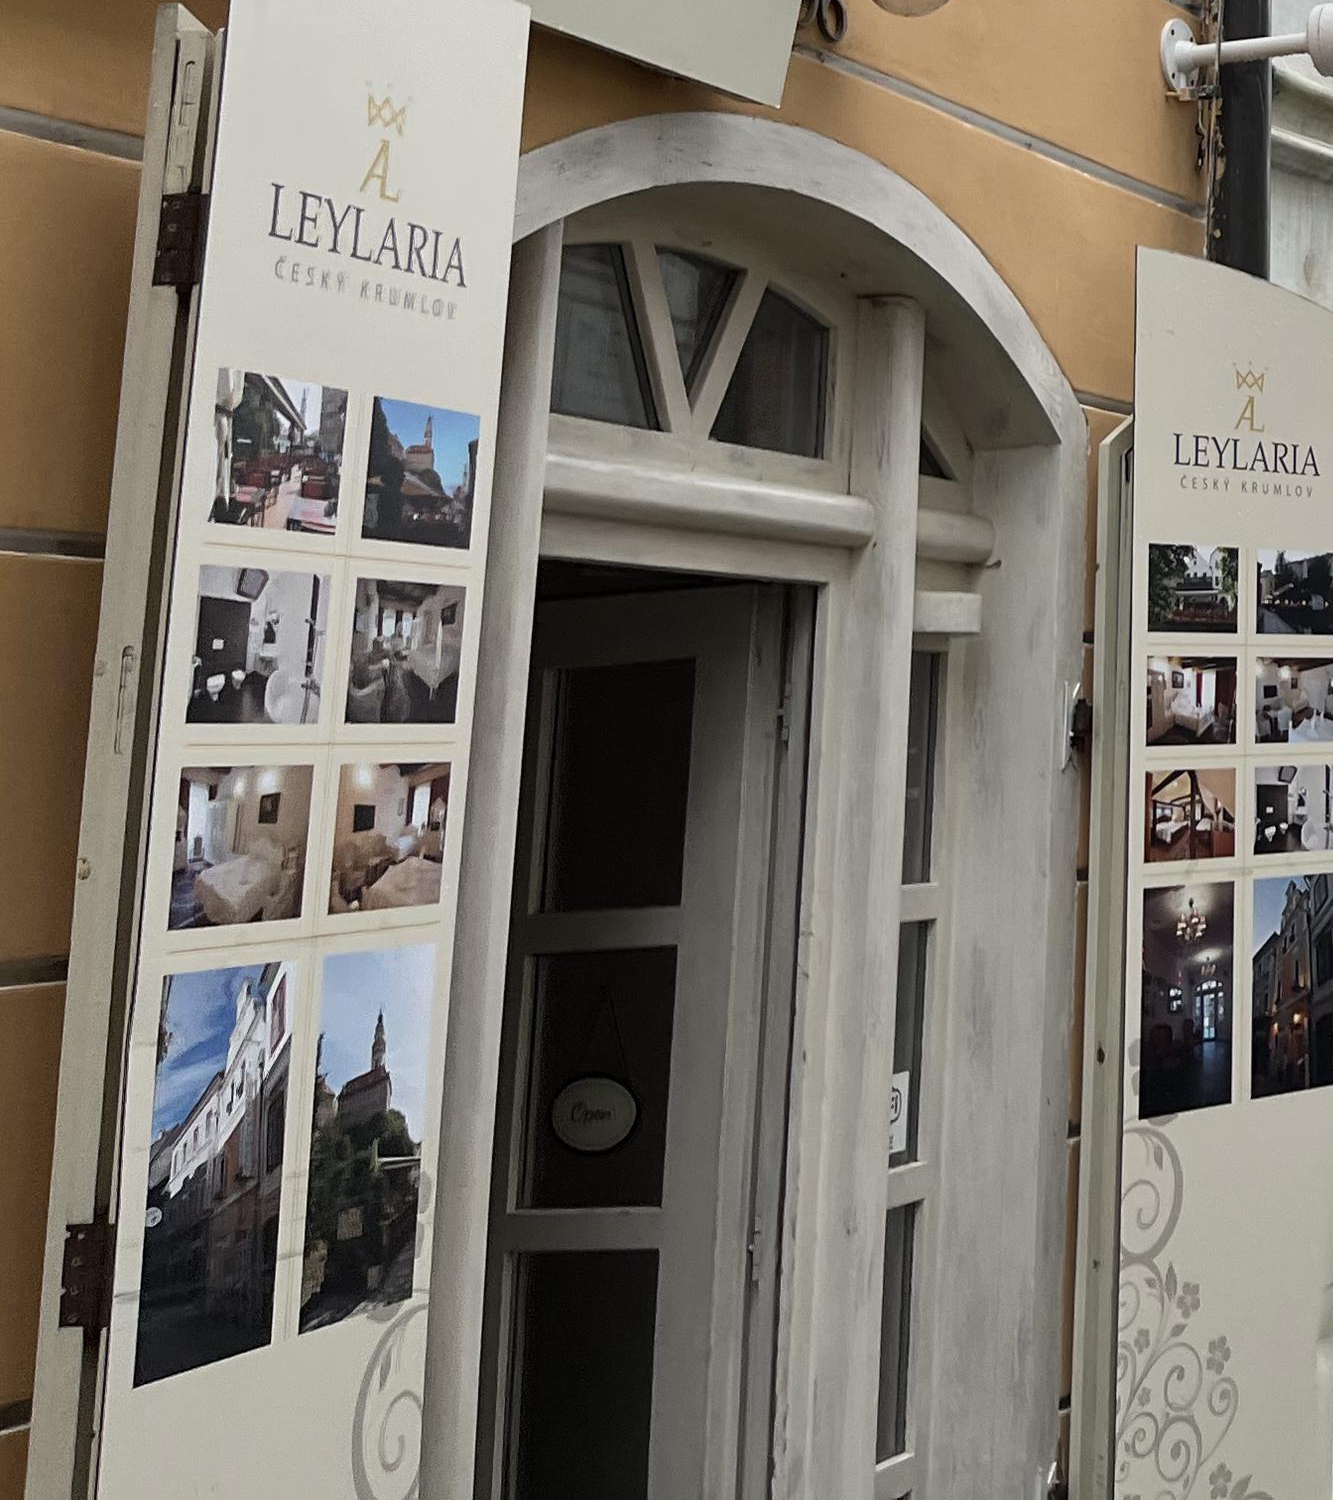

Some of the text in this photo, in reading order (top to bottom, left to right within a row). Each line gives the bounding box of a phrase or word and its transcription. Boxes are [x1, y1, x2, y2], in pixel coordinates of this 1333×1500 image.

[267, 182, 468, 288] LEYLARIA
[1173, 433, 1321, 477] LEYLARIA
[1241, 480, 1314, 498] KRUMLOV
